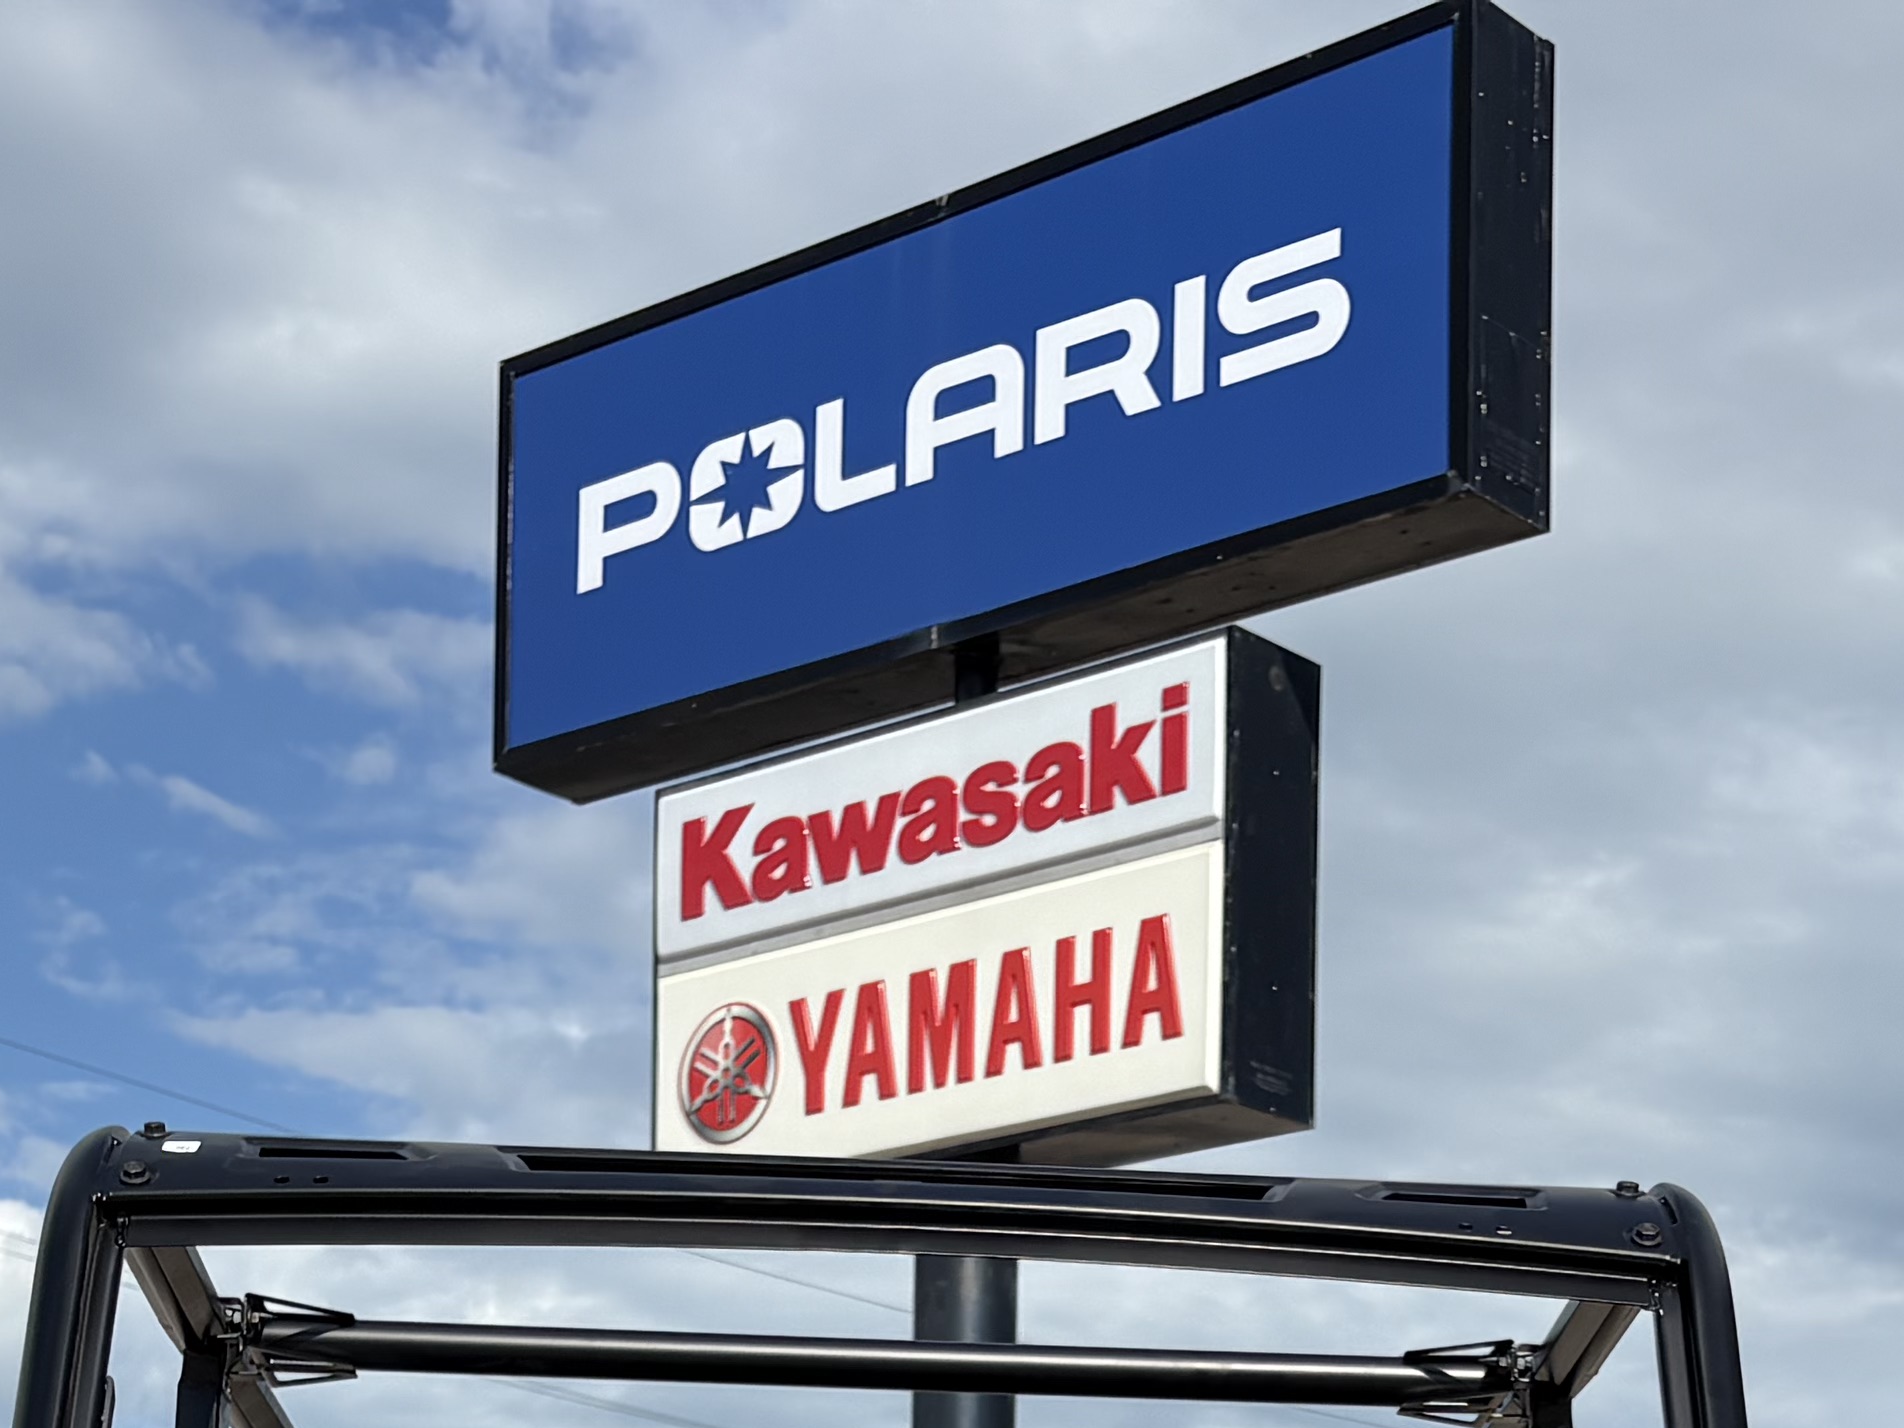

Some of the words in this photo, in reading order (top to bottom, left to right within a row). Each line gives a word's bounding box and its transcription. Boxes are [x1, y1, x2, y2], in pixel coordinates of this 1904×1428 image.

[575, 227, 1352, 595] POLARIS
[679, 681, 1190, 922] Kawasaki
[788, 913, 1184, 1116] YAMAHA
